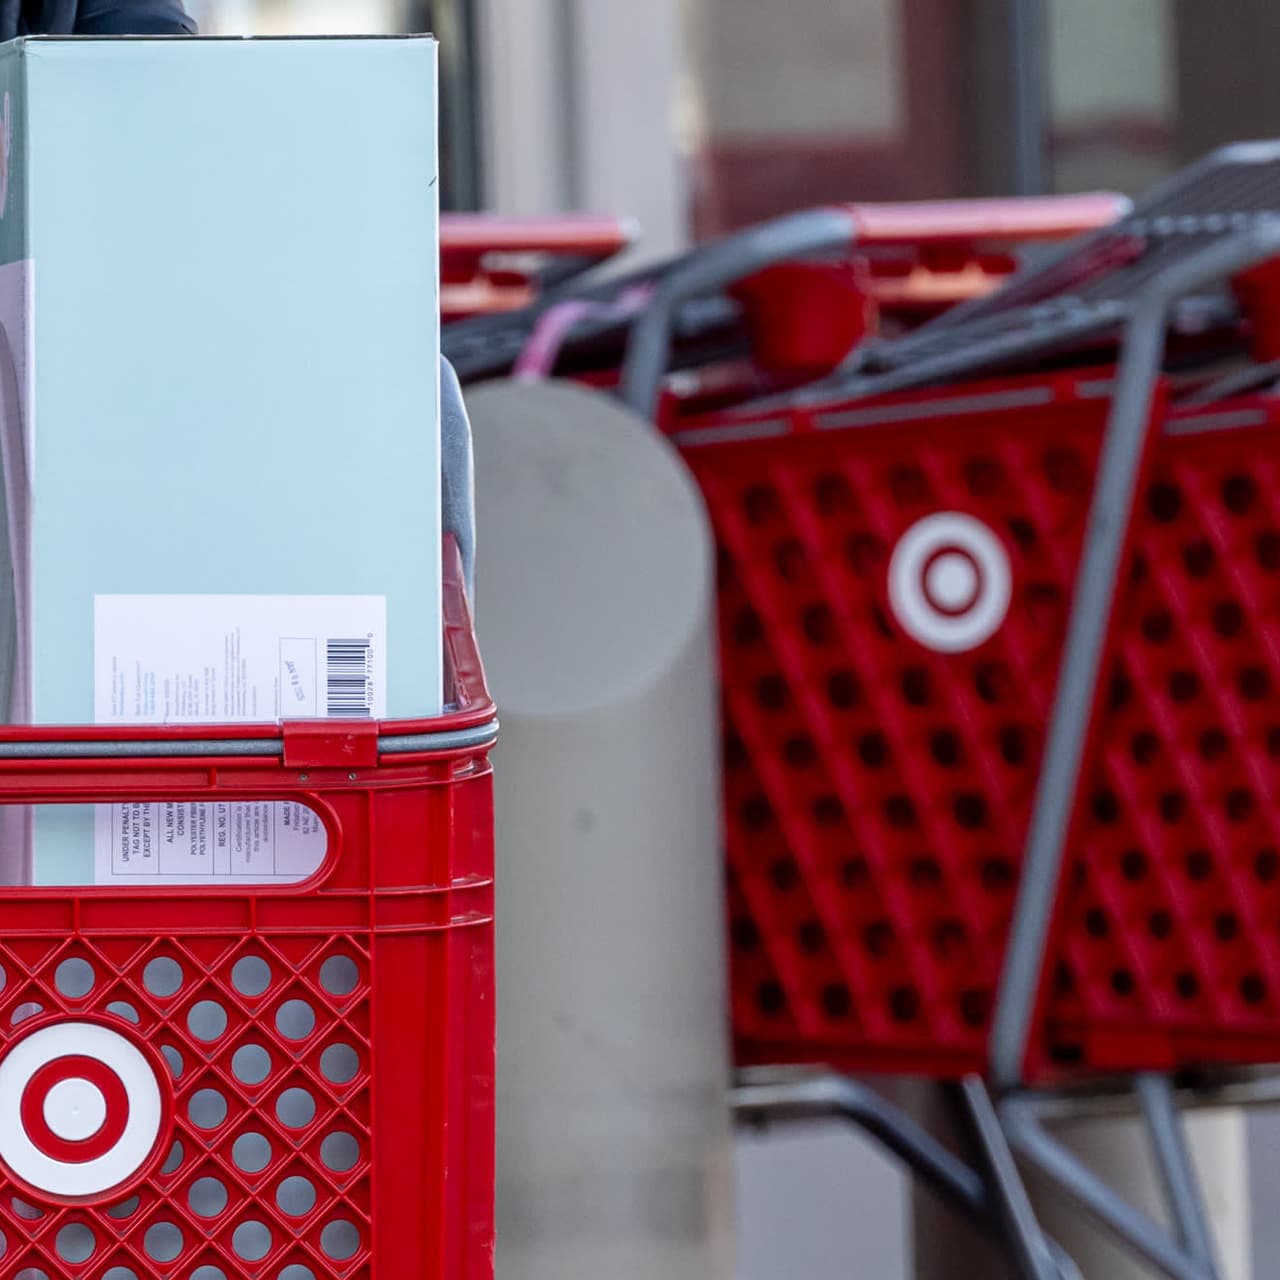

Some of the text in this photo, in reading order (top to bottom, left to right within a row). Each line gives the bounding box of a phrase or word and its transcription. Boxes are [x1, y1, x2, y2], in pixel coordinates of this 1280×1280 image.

[366, 648, 374, 674] 77100
[366, 681, 374, 706] 10028
[132, 810, 140, 821] TO
[143, 817, 151, 827] BY
[166, 810, 174, 828] NEW
[177, 804, 185, 836] CONSIST
[218, 815, 226, 828] NO.
[132, 822, 140, 838] NOT
[166, 829, 174, 843] ALL
[218, 829, 226, 847] REG.
[121, 836, 130, 862] UNDER
[132, 839, 140, 854] TAG
[143, 829, 151, 858] EXCEPT
